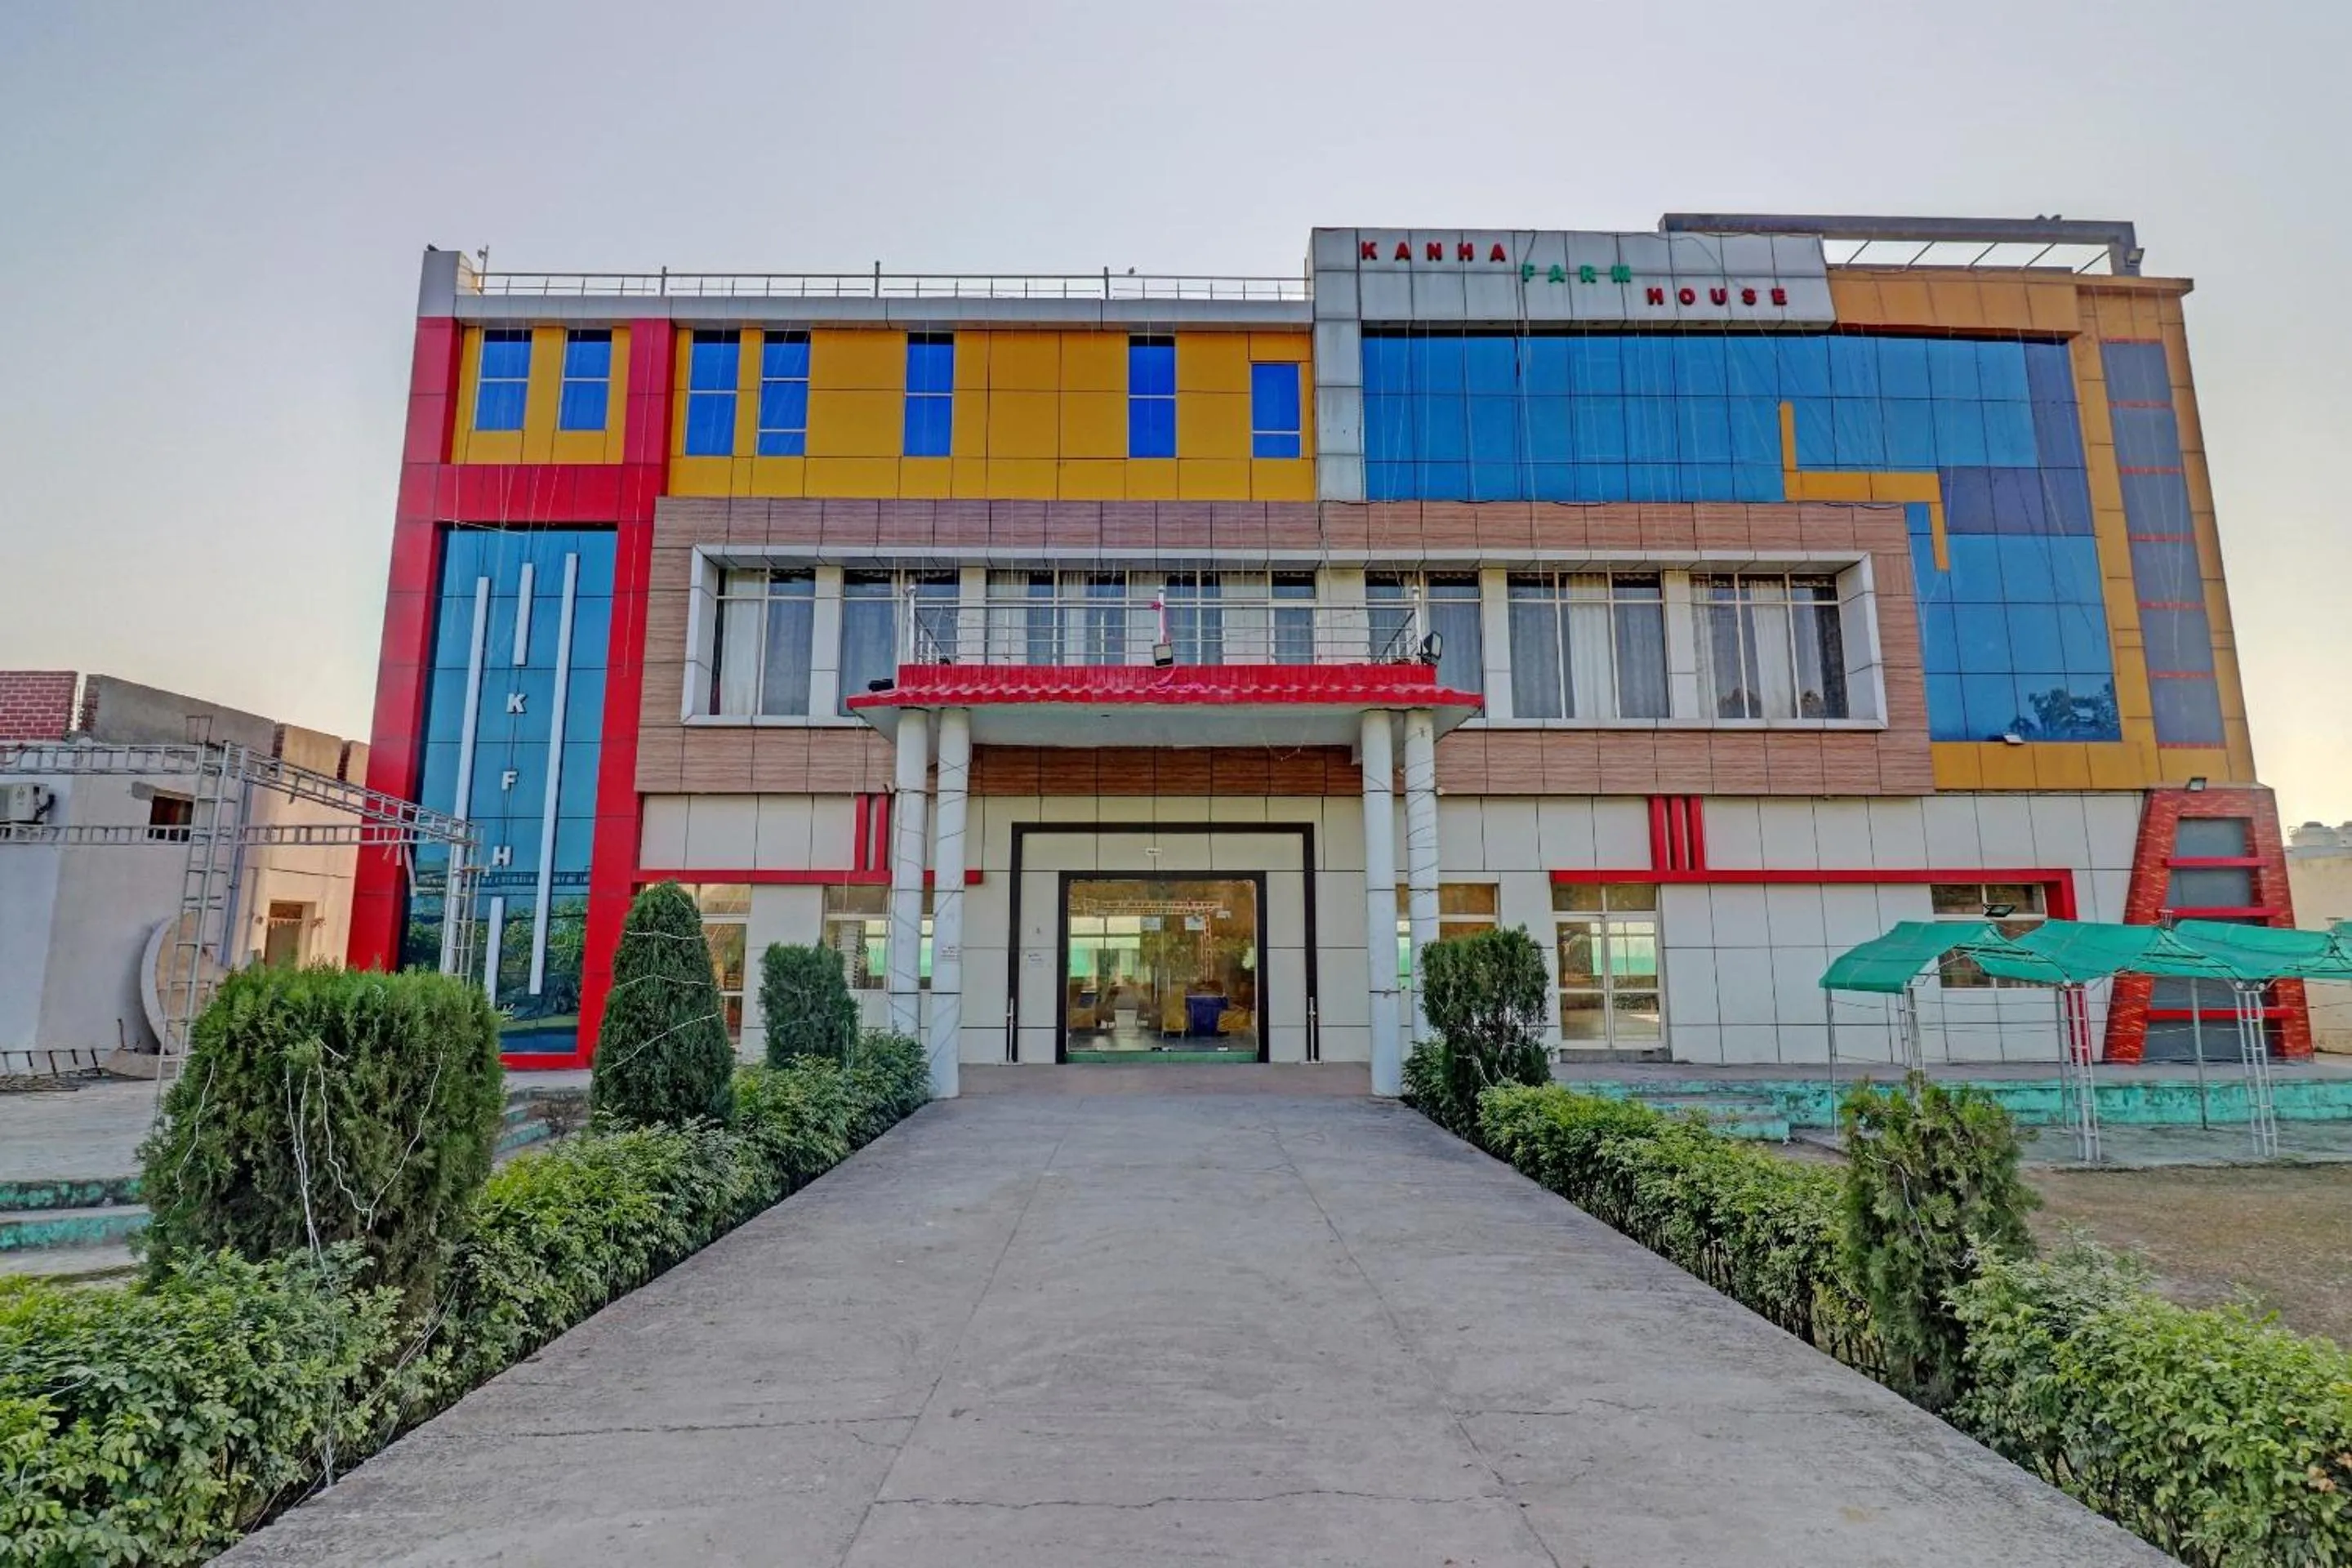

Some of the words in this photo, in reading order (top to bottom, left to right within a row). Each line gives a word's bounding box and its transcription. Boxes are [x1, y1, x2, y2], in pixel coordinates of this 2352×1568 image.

[1361, 241, 1506, 262] KANHA
[1521, 264, 1631, 283] FARM
[1647, 288, 1787, 306] HOUSE
